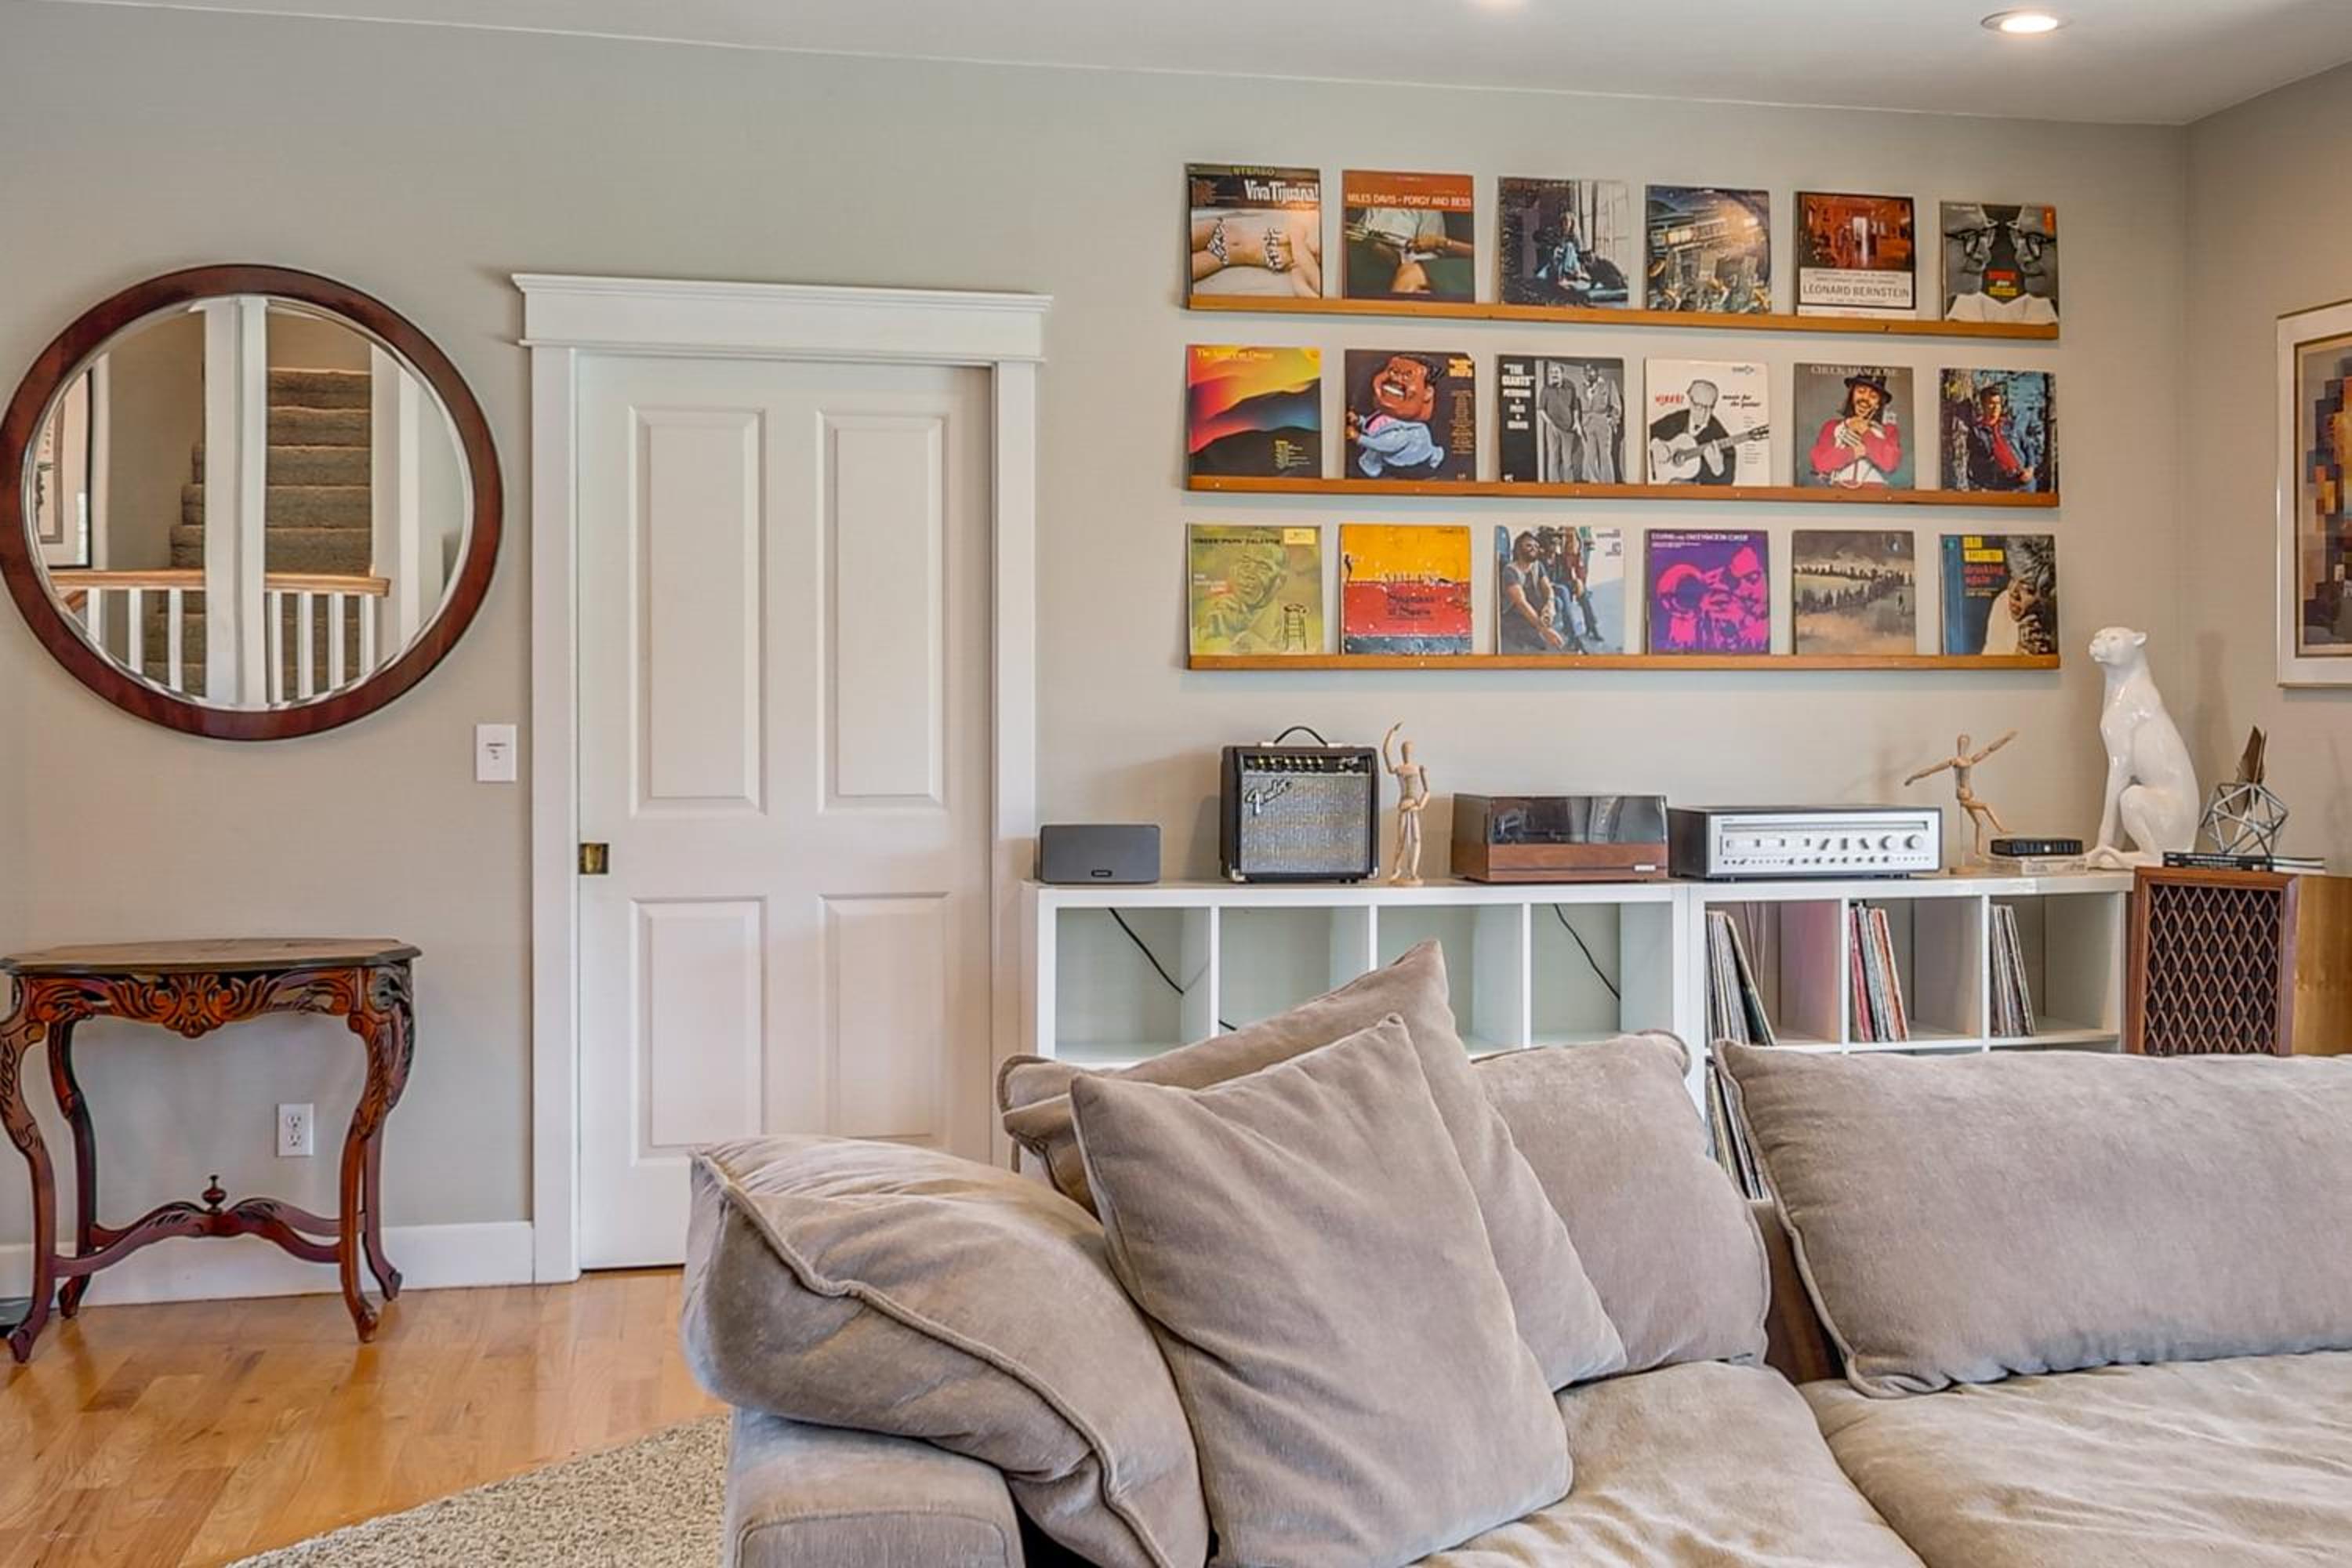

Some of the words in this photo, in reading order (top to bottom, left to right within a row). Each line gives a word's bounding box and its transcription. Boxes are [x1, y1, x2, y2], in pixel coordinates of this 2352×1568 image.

[1243, 179, 1269, 201] Viva
[1269, 180, 1319, 205] Tijuana!
[1347, 192, 1372, 204] MILES
[1373, 194, 1398, 205] DAVIS
[1403, 194, 1430, 206] PORGY
[1431, 195, 1450, 207] AND
[1450, 196, 1472, 208] BESS
[1802, 284, 1851, 296] LEONARD
[1853, 285, 1910, 299] BERNSTEIN
